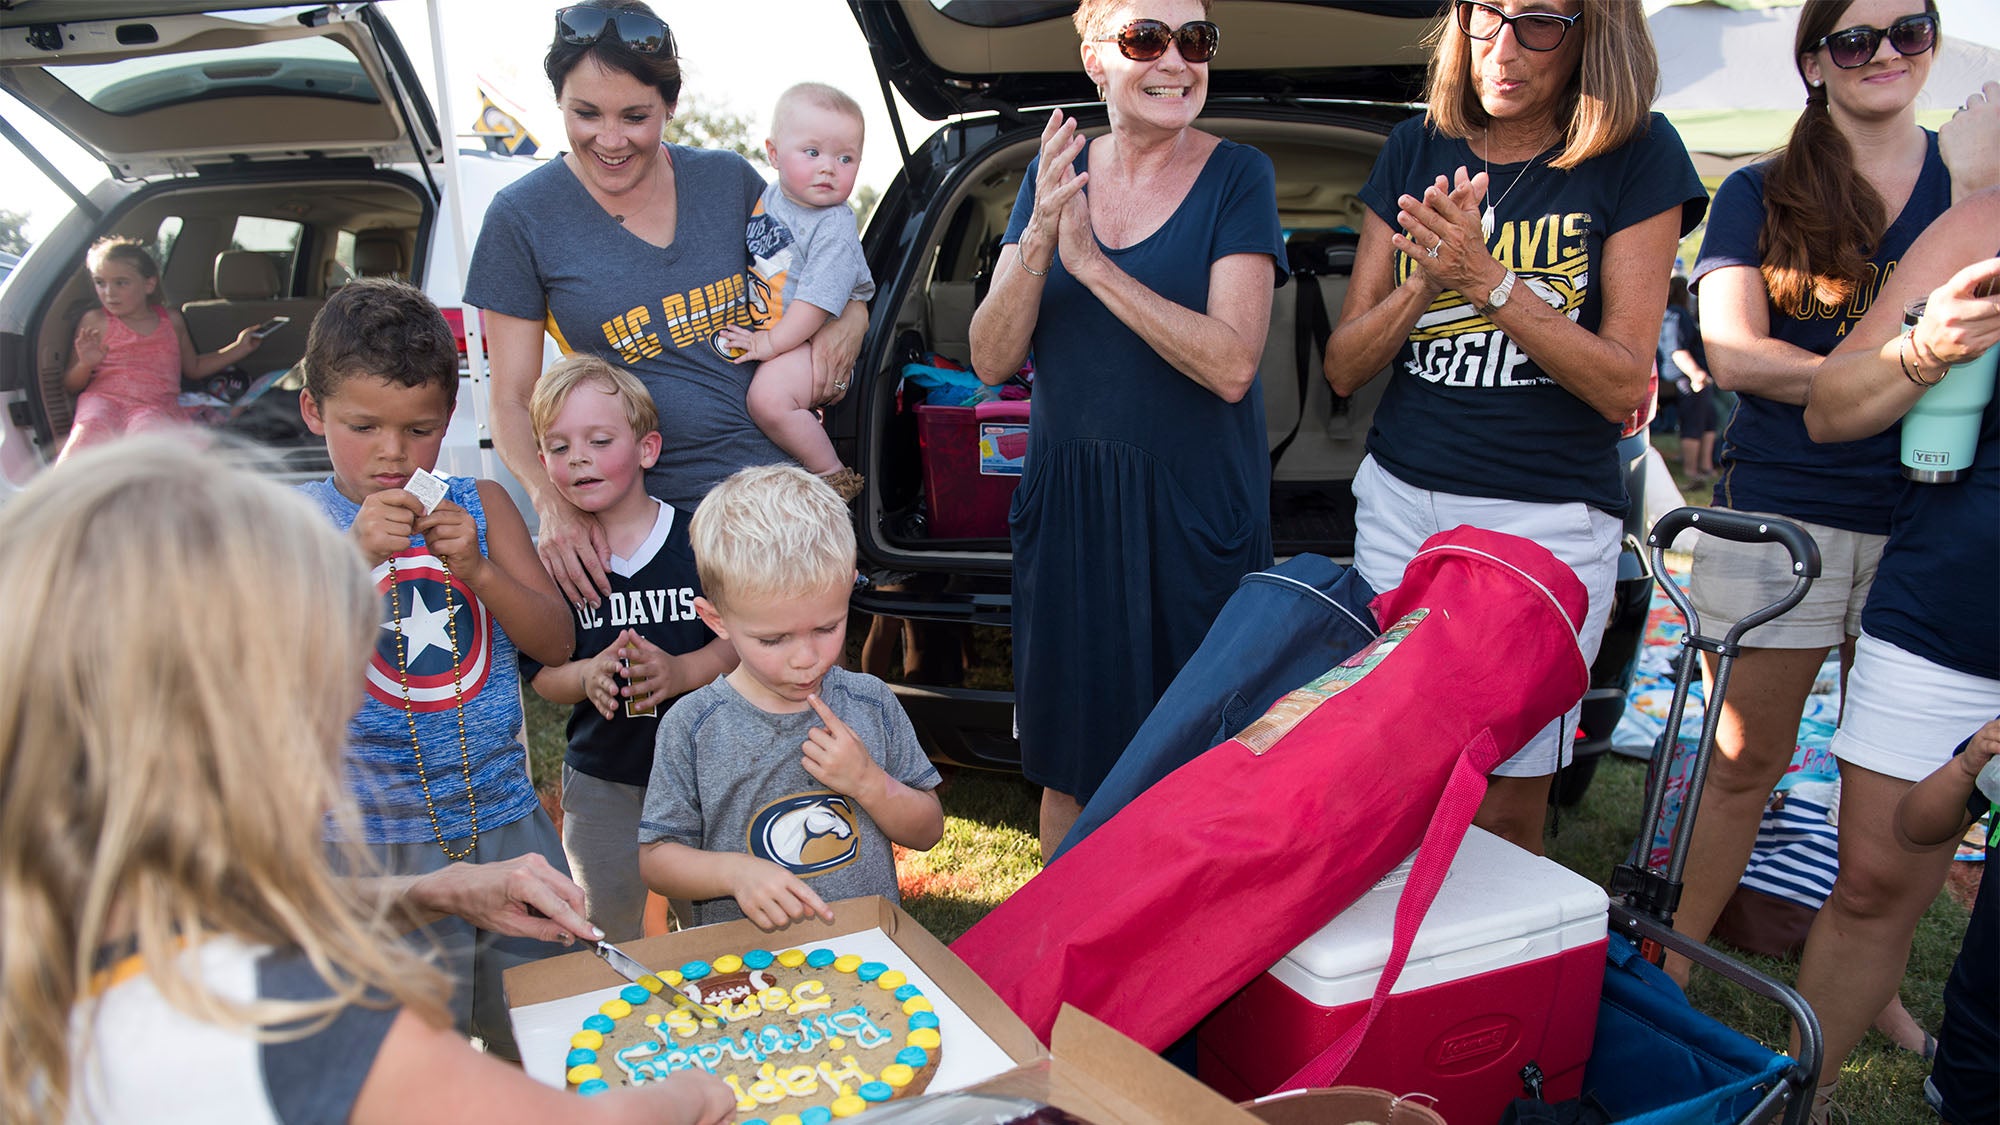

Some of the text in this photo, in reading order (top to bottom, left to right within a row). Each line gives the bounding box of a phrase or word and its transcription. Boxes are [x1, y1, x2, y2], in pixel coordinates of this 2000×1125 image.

[1481, 212, 1592, 272] AVIS
[601, 273, 752, 365] UC DAVIS
[1915, 451, 1946, 463] YETI
[608, 587, 698, 627] DAVIS
[614, 1004, 892, 1086] Birthday
